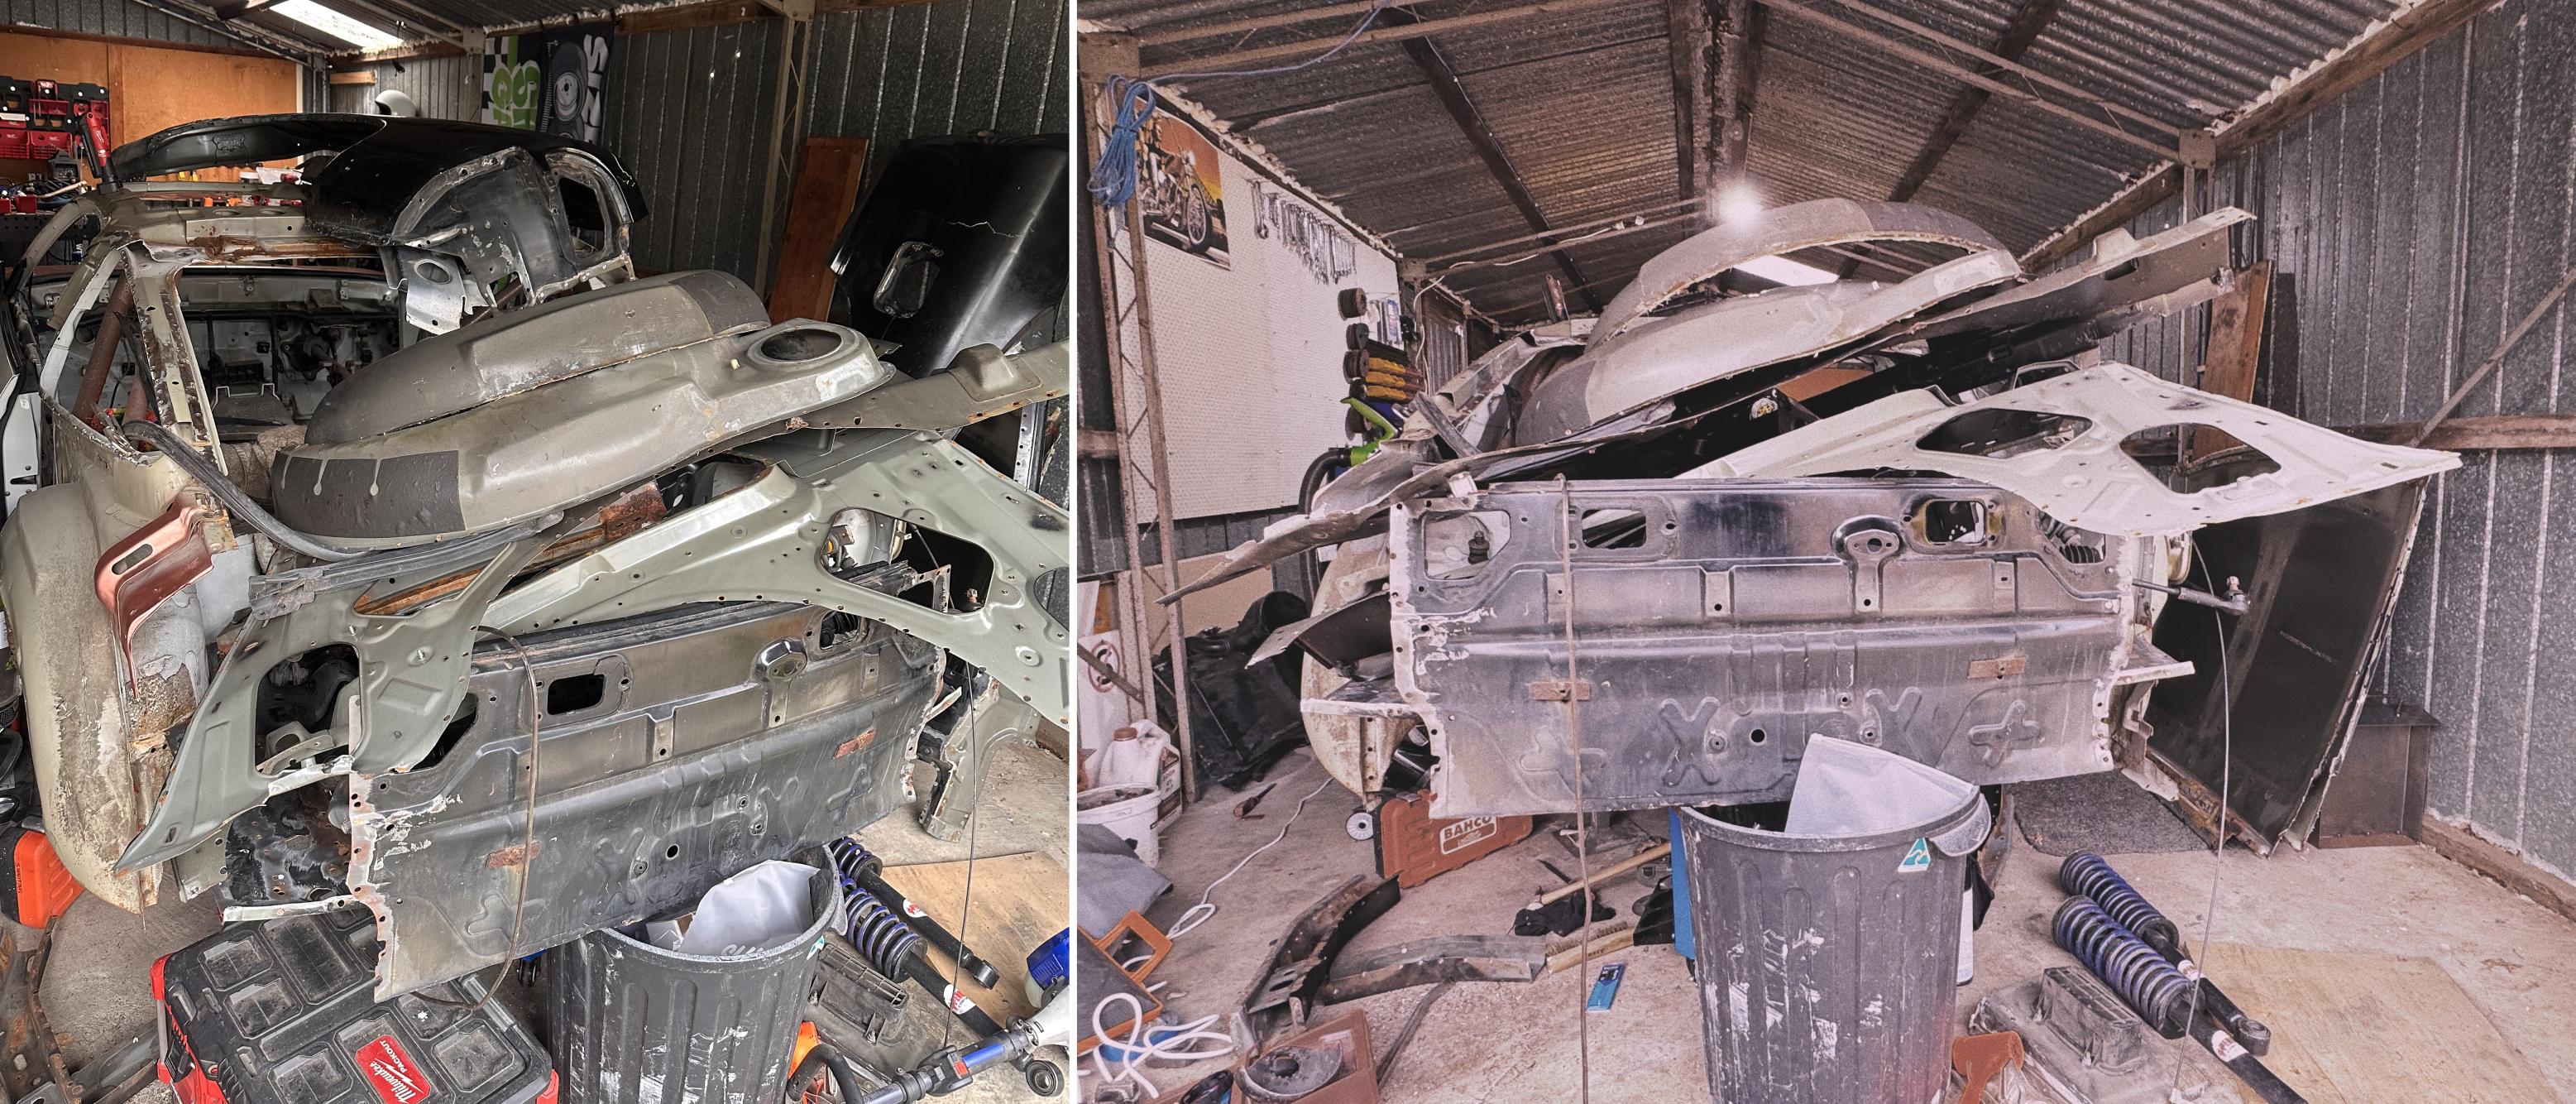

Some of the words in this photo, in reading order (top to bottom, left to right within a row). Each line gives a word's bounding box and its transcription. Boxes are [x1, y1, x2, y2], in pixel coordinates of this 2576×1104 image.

[1444, 816, 1492, 840] BAHCO
[379, 1039, 408, 1074] PACKOUT
[368, 1061, 416, 1104] Milwaukee
